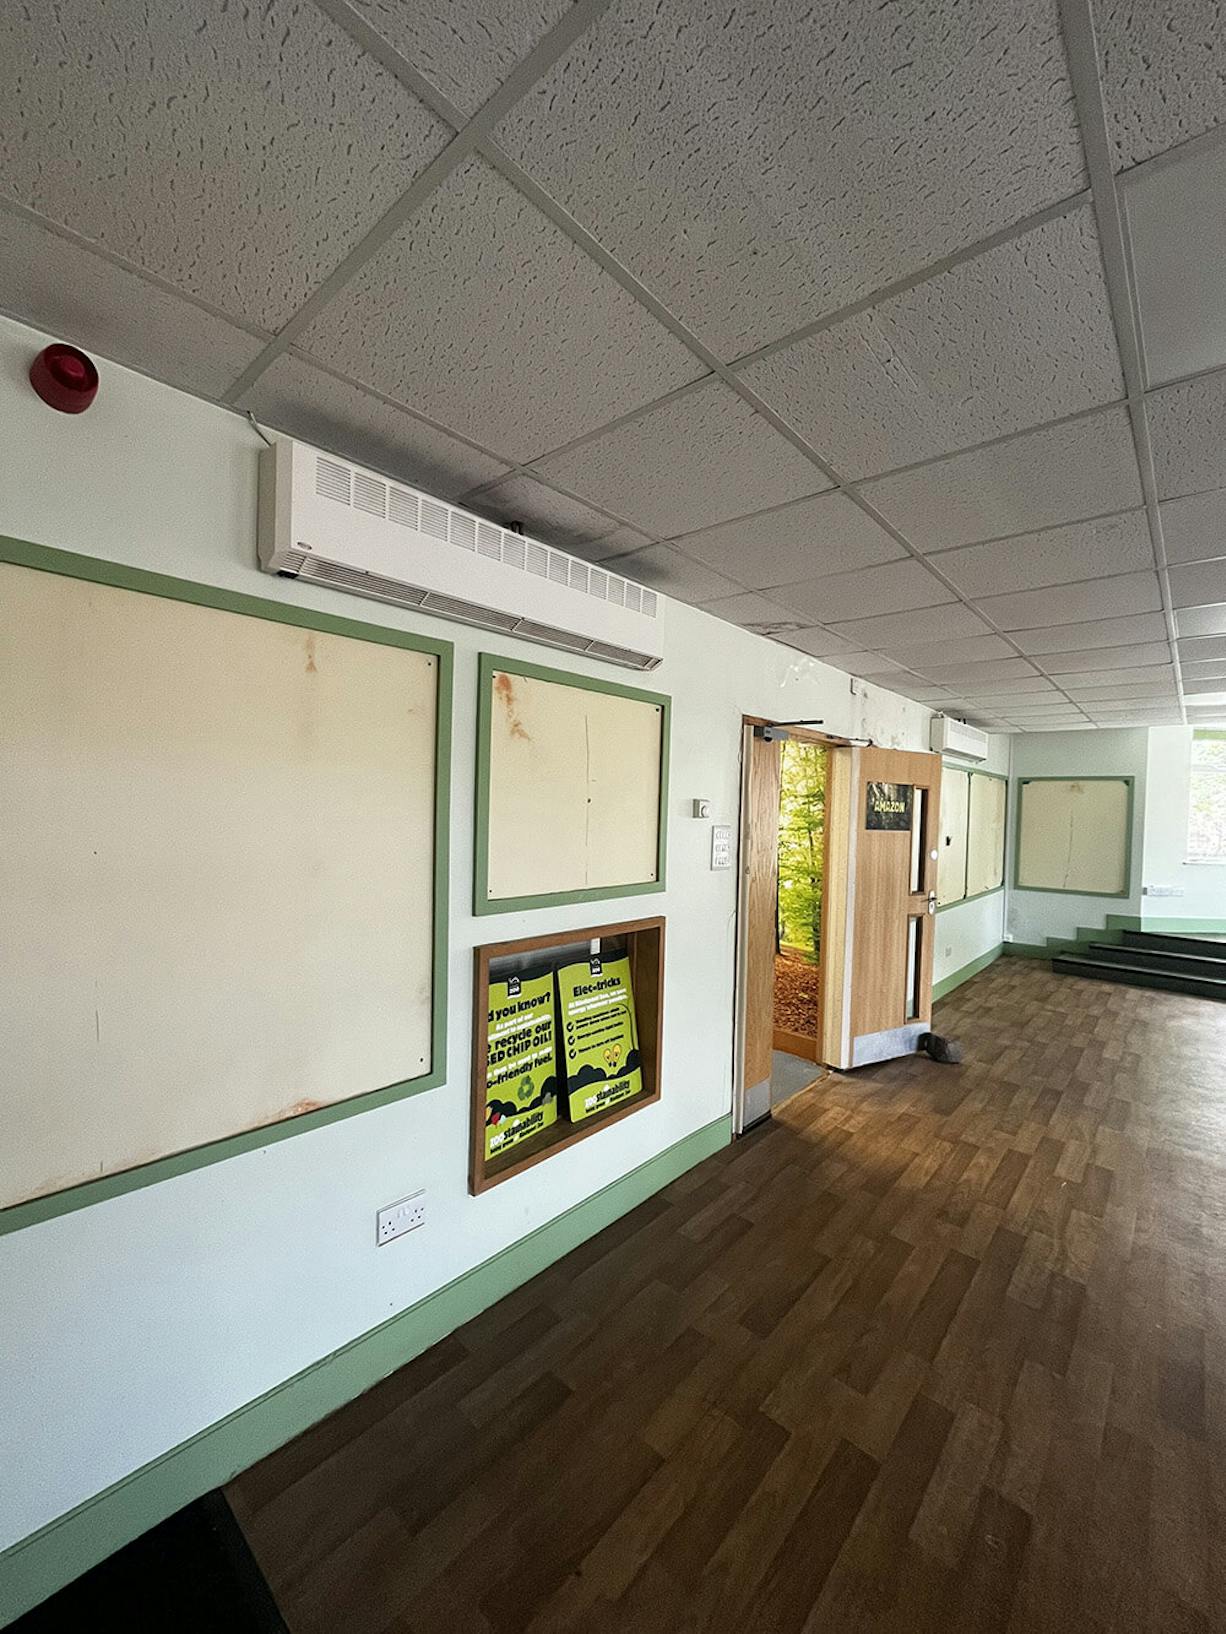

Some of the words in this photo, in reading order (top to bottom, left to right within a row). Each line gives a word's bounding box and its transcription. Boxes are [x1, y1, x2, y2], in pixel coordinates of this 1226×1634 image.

[874, 800, 906, 813] AMAZON
[573, 977, 621, 997] Elec-tricks
[496, 1004, 516, 1021] you
[517, 991, 551, 1012] know?
[495, 1028, 532, 1050] recycle
[535, 1021, 552, 1034] our
[507, 1039, 531, 1059] CHIP
[533, 1031, 552, 1048] OIL!
